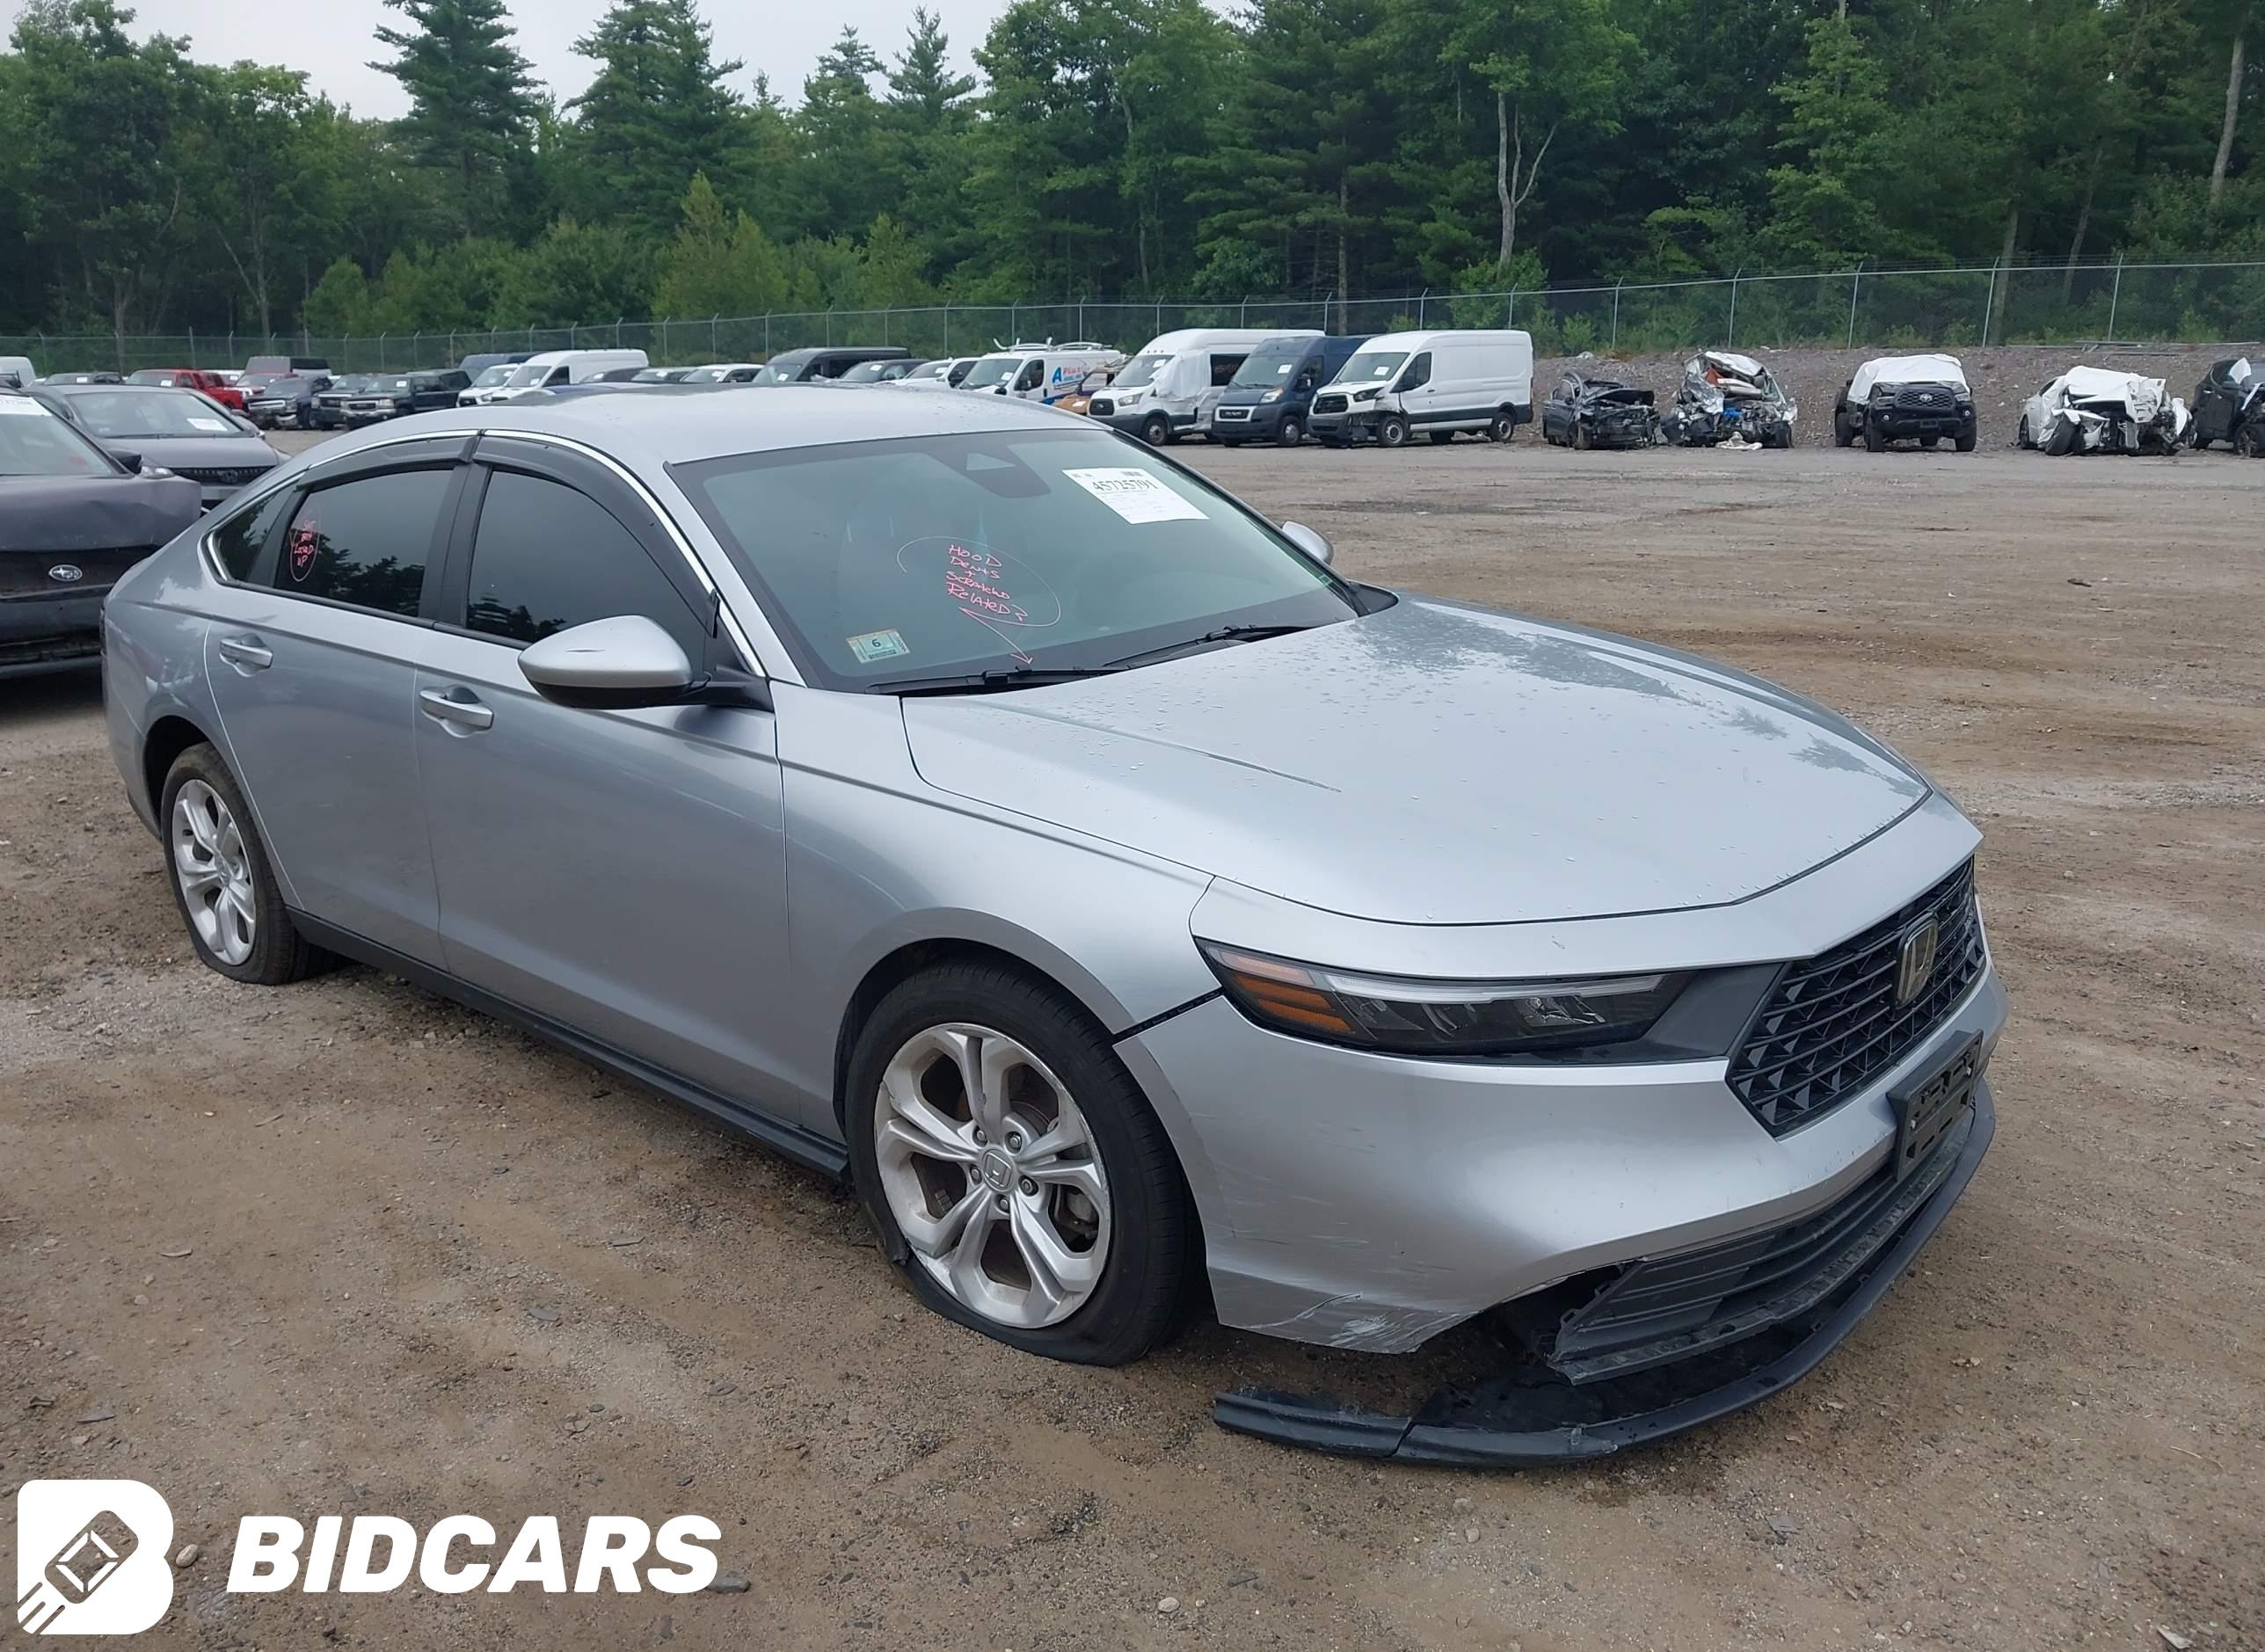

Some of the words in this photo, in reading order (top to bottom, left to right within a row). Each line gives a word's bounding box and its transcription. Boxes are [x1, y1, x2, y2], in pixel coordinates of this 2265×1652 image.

[1092, 479, 1159, 491] 45725791
[948, 543, 1002, 568] HOOD
[871, 638, 882, 648] 6
